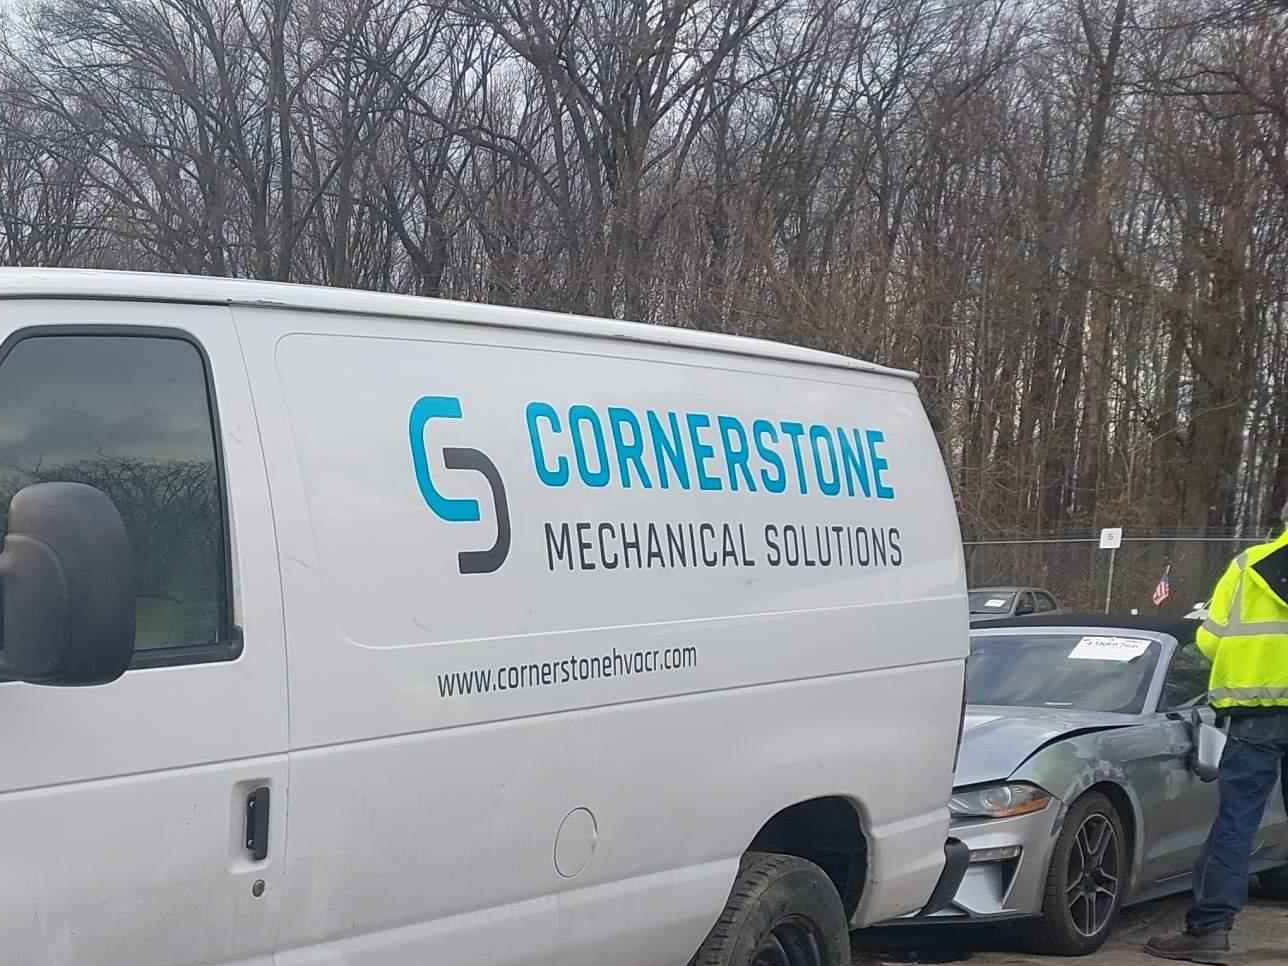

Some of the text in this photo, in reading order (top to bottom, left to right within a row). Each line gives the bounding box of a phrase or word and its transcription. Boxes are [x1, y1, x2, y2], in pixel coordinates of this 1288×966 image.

[525, 400, 896, 500] CORNERSTONE
[544, 521, 903, 572] MECHANICAL SOLUTIONS
[437, 645, 697, 698] www.cornerstonehvacr.com
